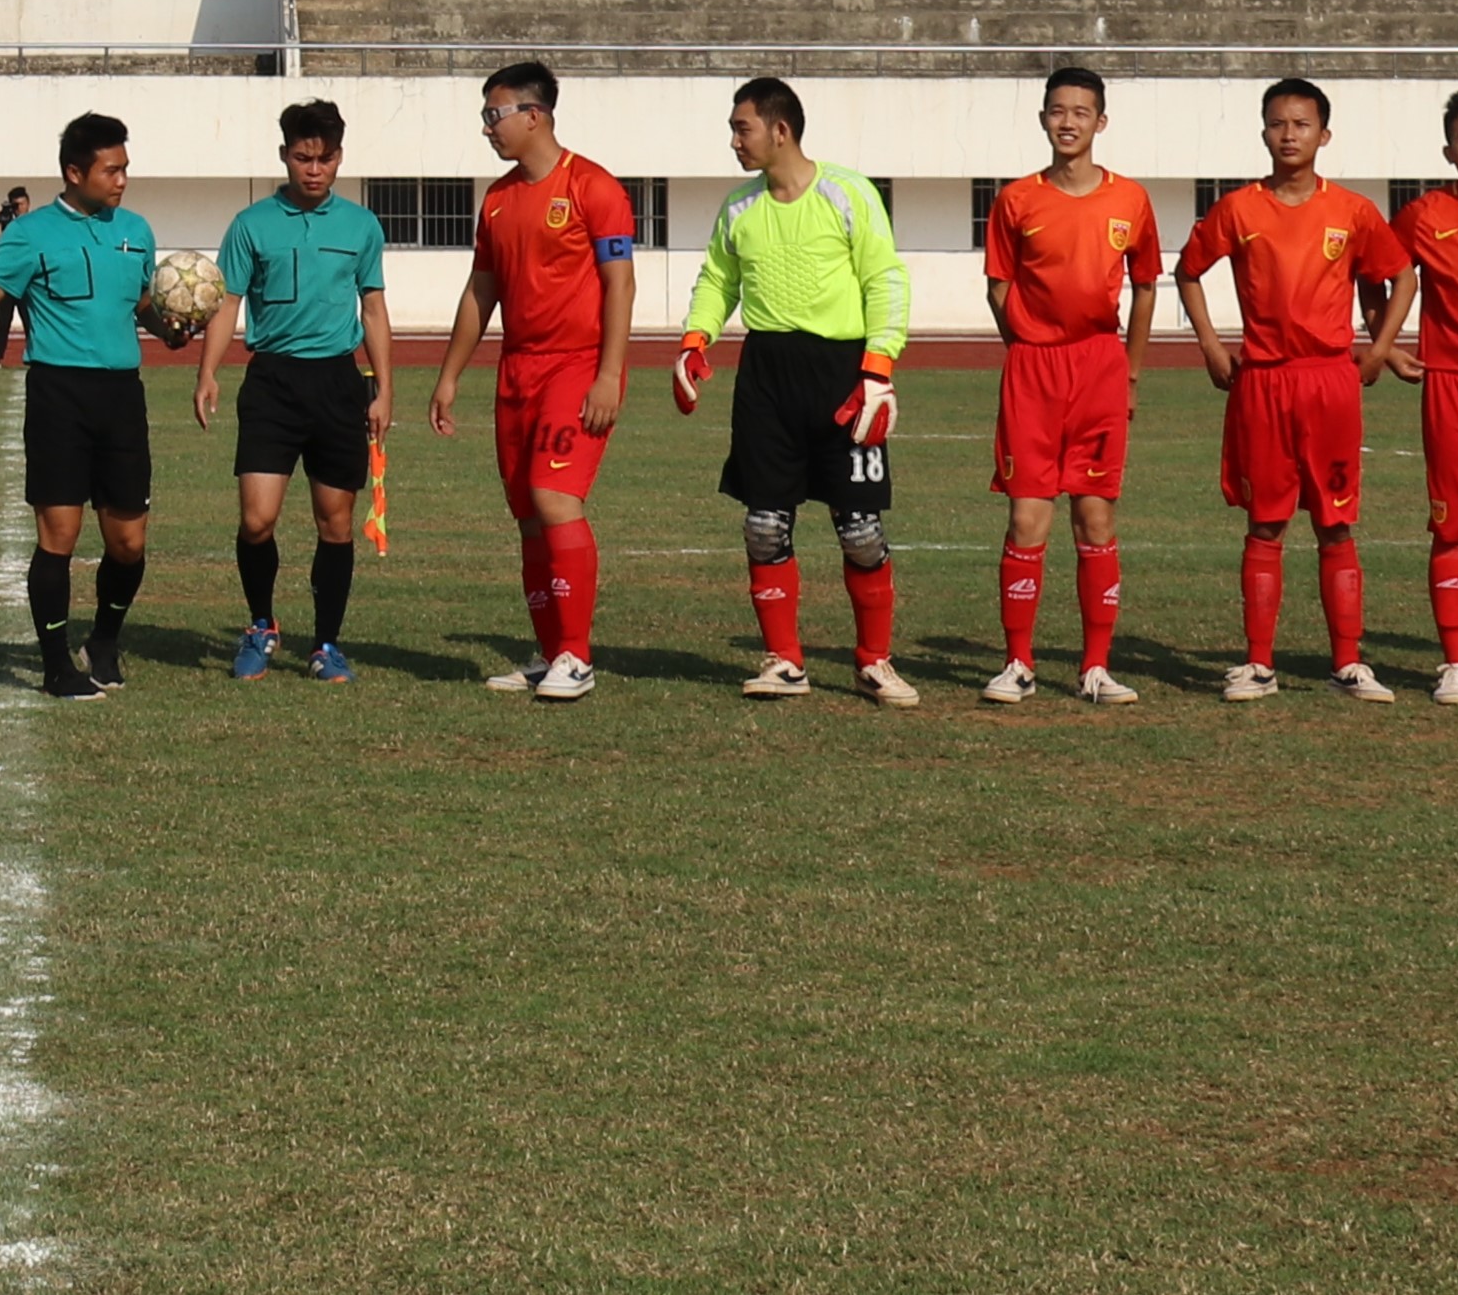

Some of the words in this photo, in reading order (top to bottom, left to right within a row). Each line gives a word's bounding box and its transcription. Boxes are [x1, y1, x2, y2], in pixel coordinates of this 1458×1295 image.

[607, 238, 624, 257] C
[537, 423, 577, 455] 16
[849, 445, 884, 482] 18
[1328, 461, 1349, 492] 3
